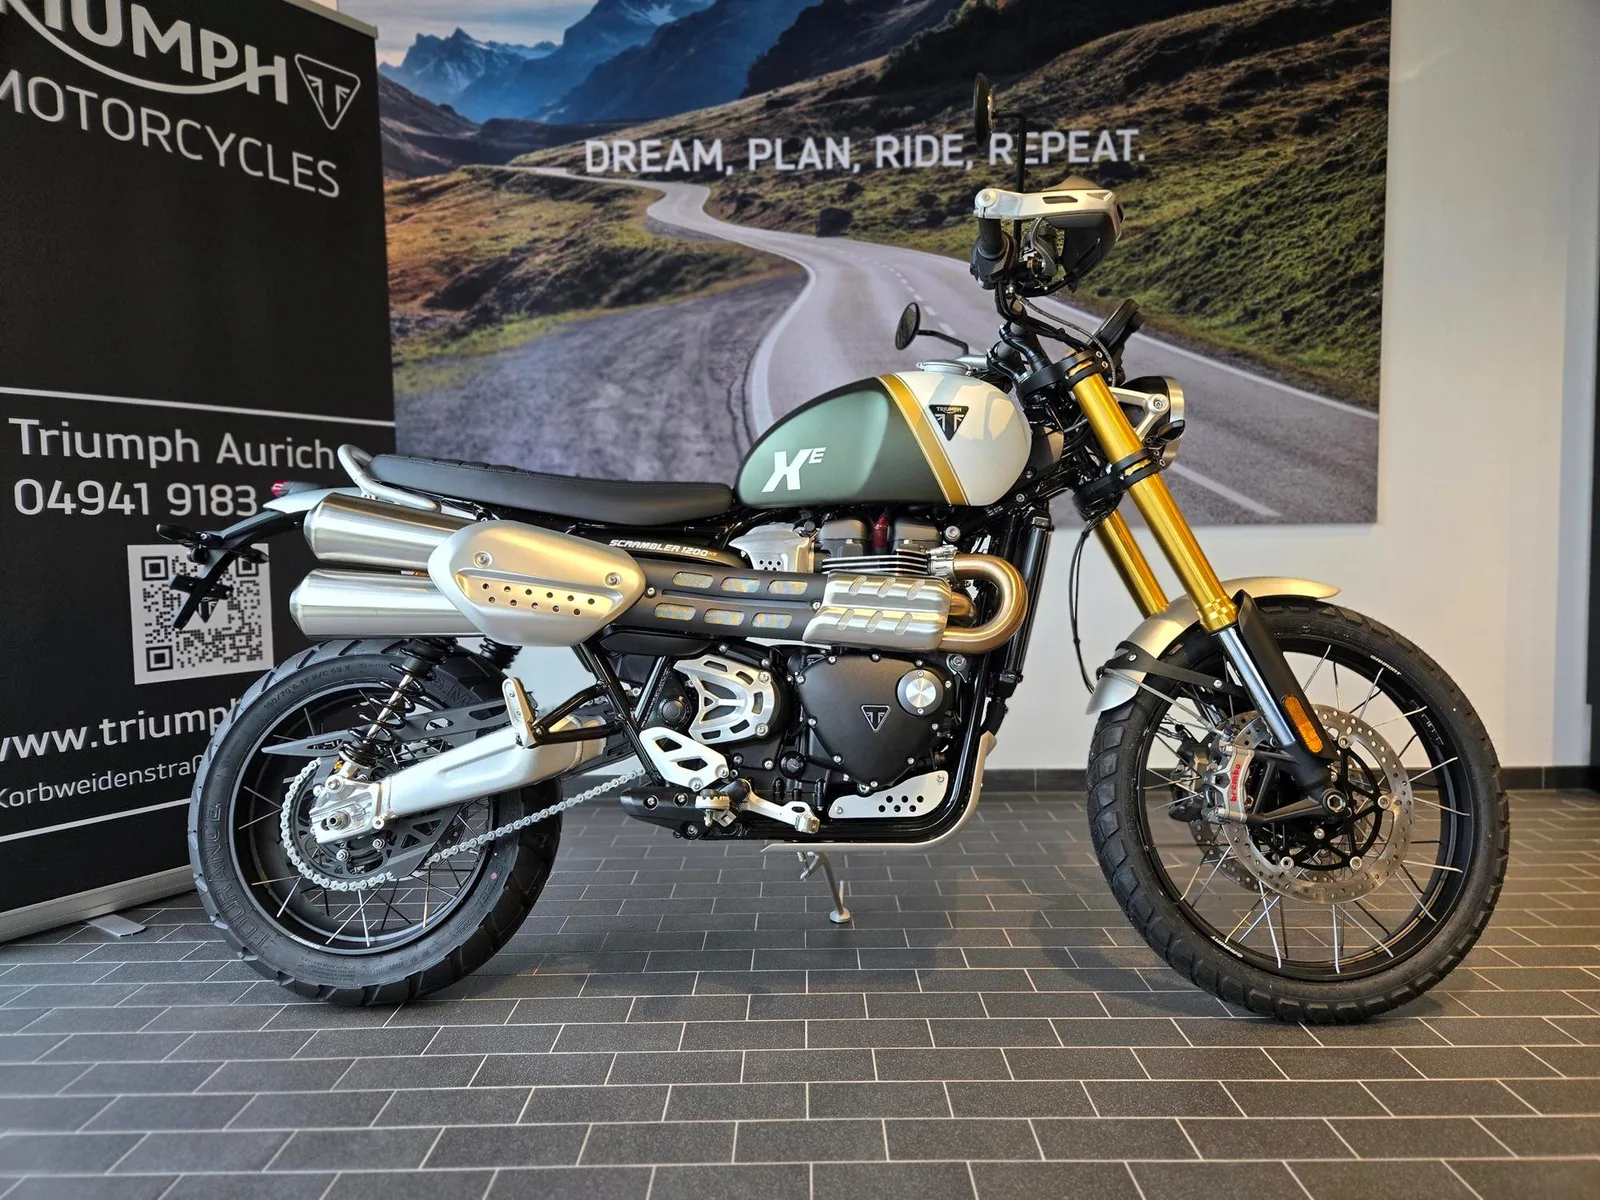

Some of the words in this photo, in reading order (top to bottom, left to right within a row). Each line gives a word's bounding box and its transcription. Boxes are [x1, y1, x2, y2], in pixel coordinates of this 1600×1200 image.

[585, 137, 734, 176] DREAM,
[748, 136, 861, 174] PLAN,
[876, 133, 973, 170] RIDE,
[989, 128, 1146, 167] REPEAT.
[8, 417, 200, 469] Triumph
[216, 432, 335, 470] Aurich
[14, 478, 149, 516] 04941
[167, 482, 258, 517] 9183
[609, 539, 681, 553] SCRAMBLER
[1230, 764, 1241, 803] brembo
